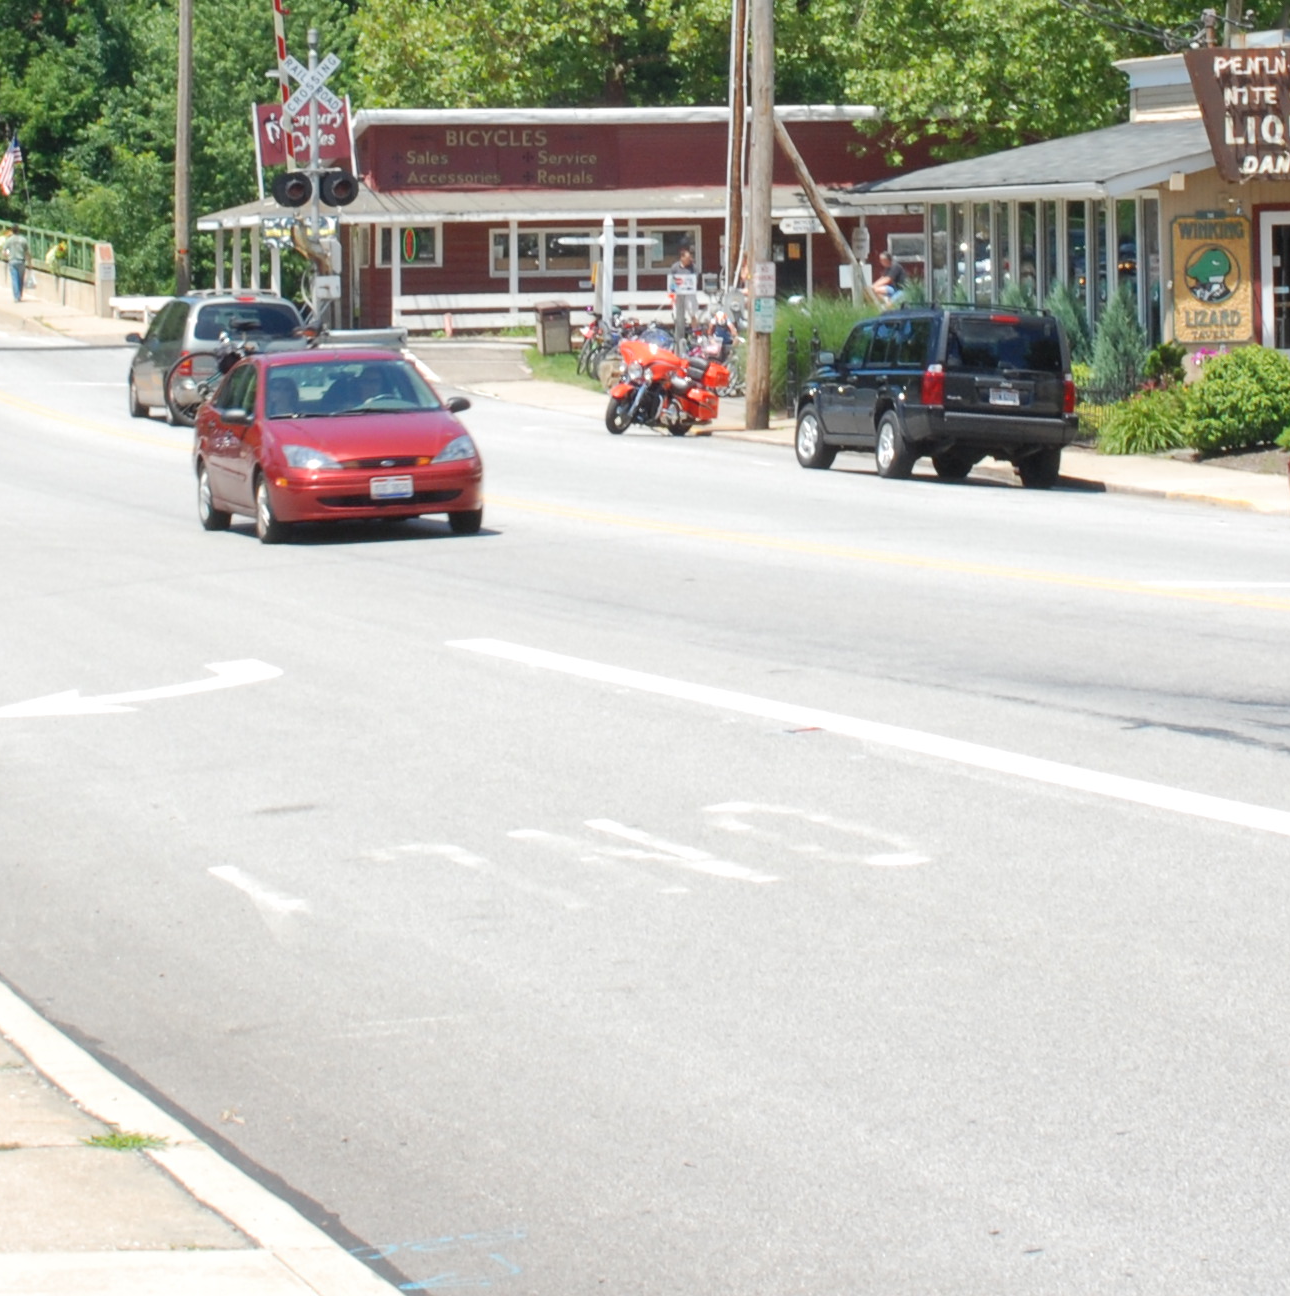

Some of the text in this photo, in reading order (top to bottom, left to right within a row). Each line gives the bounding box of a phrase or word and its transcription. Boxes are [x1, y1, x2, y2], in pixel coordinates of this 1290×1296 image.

[284, 58, 340, 111] RAIL ROAD
[287, 57, 338, 112] CROSSING
[1223, 86, 1278, 106] NITE
[445, 129, 548, 147] BICYCLES
[406, 151, 597, 165] Sales Service
[407, 170, 594, 185] Accessories Rentals
[1179, 222, 1244, 240] WINKING
[1185, 309, 1241, 328] LIZARD
[1192, 329, 1235, 340] TAVERN
